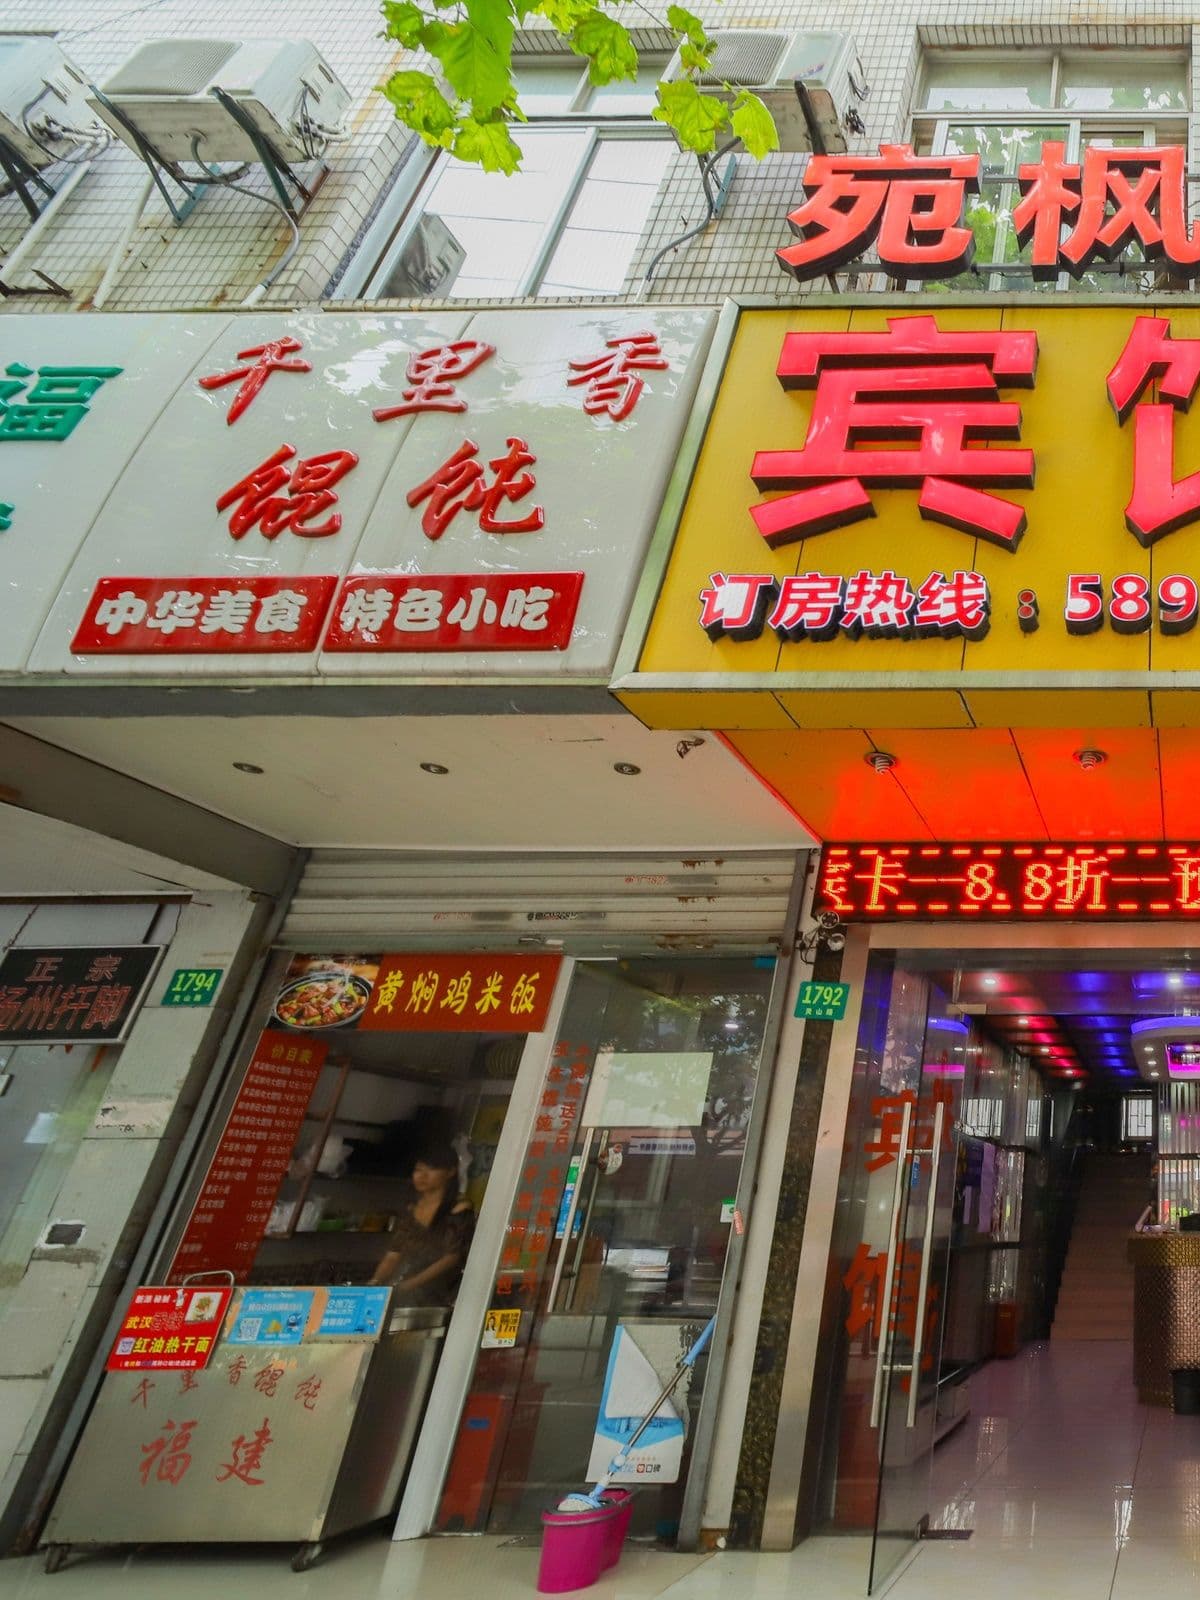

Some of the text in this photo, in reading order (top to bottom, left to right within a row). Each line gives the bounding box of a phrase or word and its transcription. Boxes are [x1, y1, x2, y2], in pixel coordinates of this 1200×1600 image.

[199, 331, 668, 425] 千里香
[216, 437, 545, 540] 馄饨
[96, 590, 307, 635] 中华美食
[340, 587, 554, 632] 特色小吃
[172, 972, 215, 992] 1794
[373, 970, 540, 1014] 黄焖鸡米饭
[802, 986, 843, 1006] 1792
[125, 1315, 153, 1329] 武汉
[132, 1336, 212, 1353] 红油热干面
[139, 1417, 273, 1487] 福建
